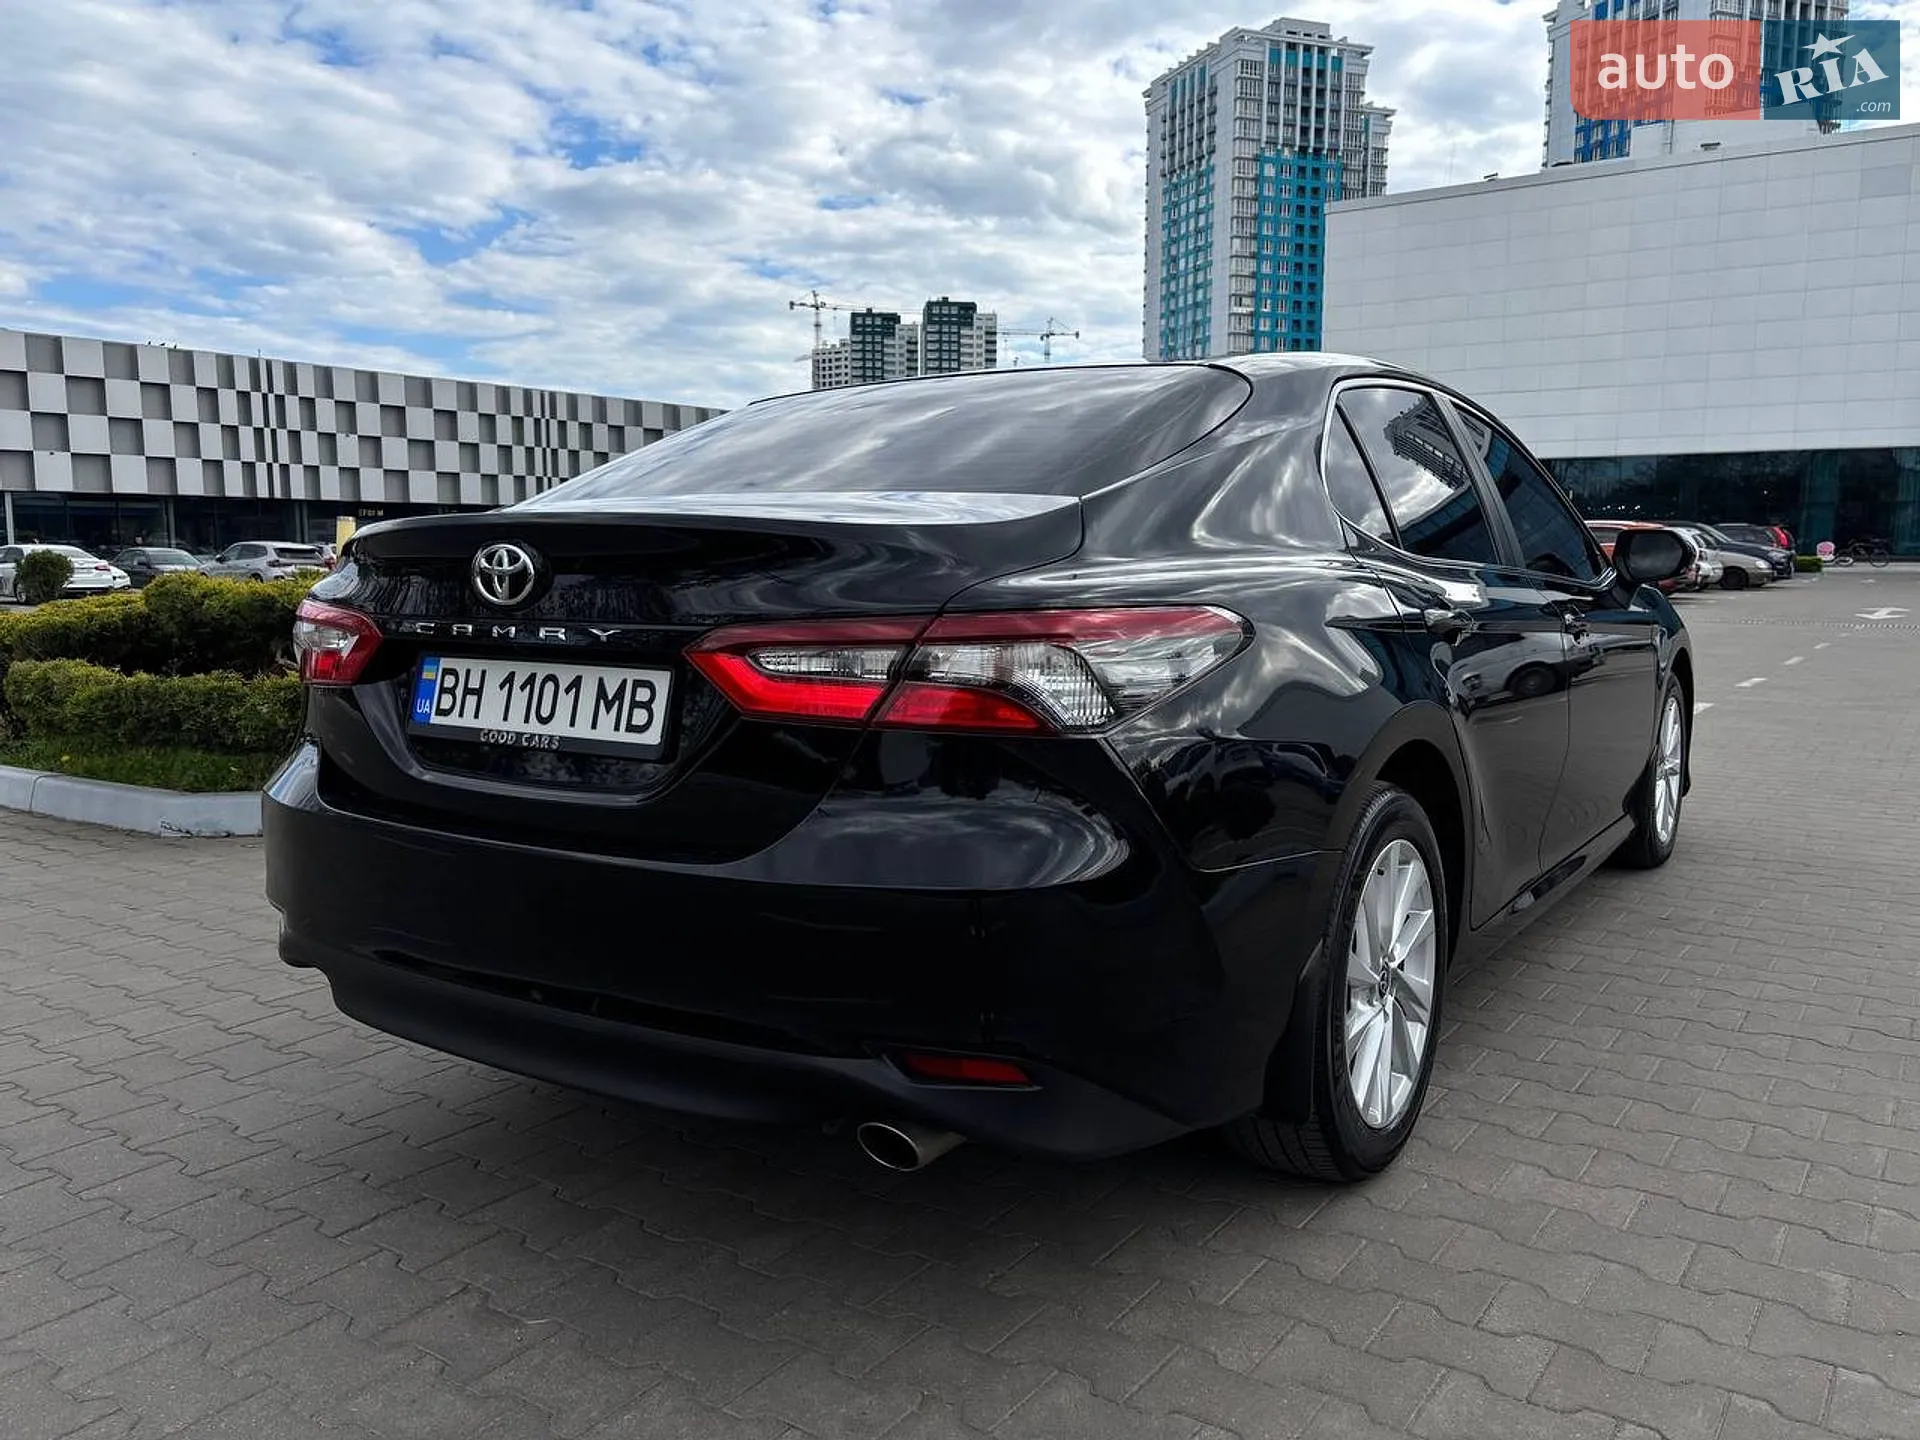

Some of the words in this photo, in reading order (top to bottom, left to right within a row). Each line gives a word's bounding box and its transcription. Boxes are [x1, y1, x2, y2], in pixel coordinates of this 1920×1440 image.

[415, 622, 621, 641] CAMRY
[416, 698, 431, 715] UA
[435, 668, 487, 719] BH
[498, 671, 583, 727] 1101
[591, 676, 657, 733] MB
[480, 729, 516, 744] GOOD
[521, 734, 561, 750] CARS
